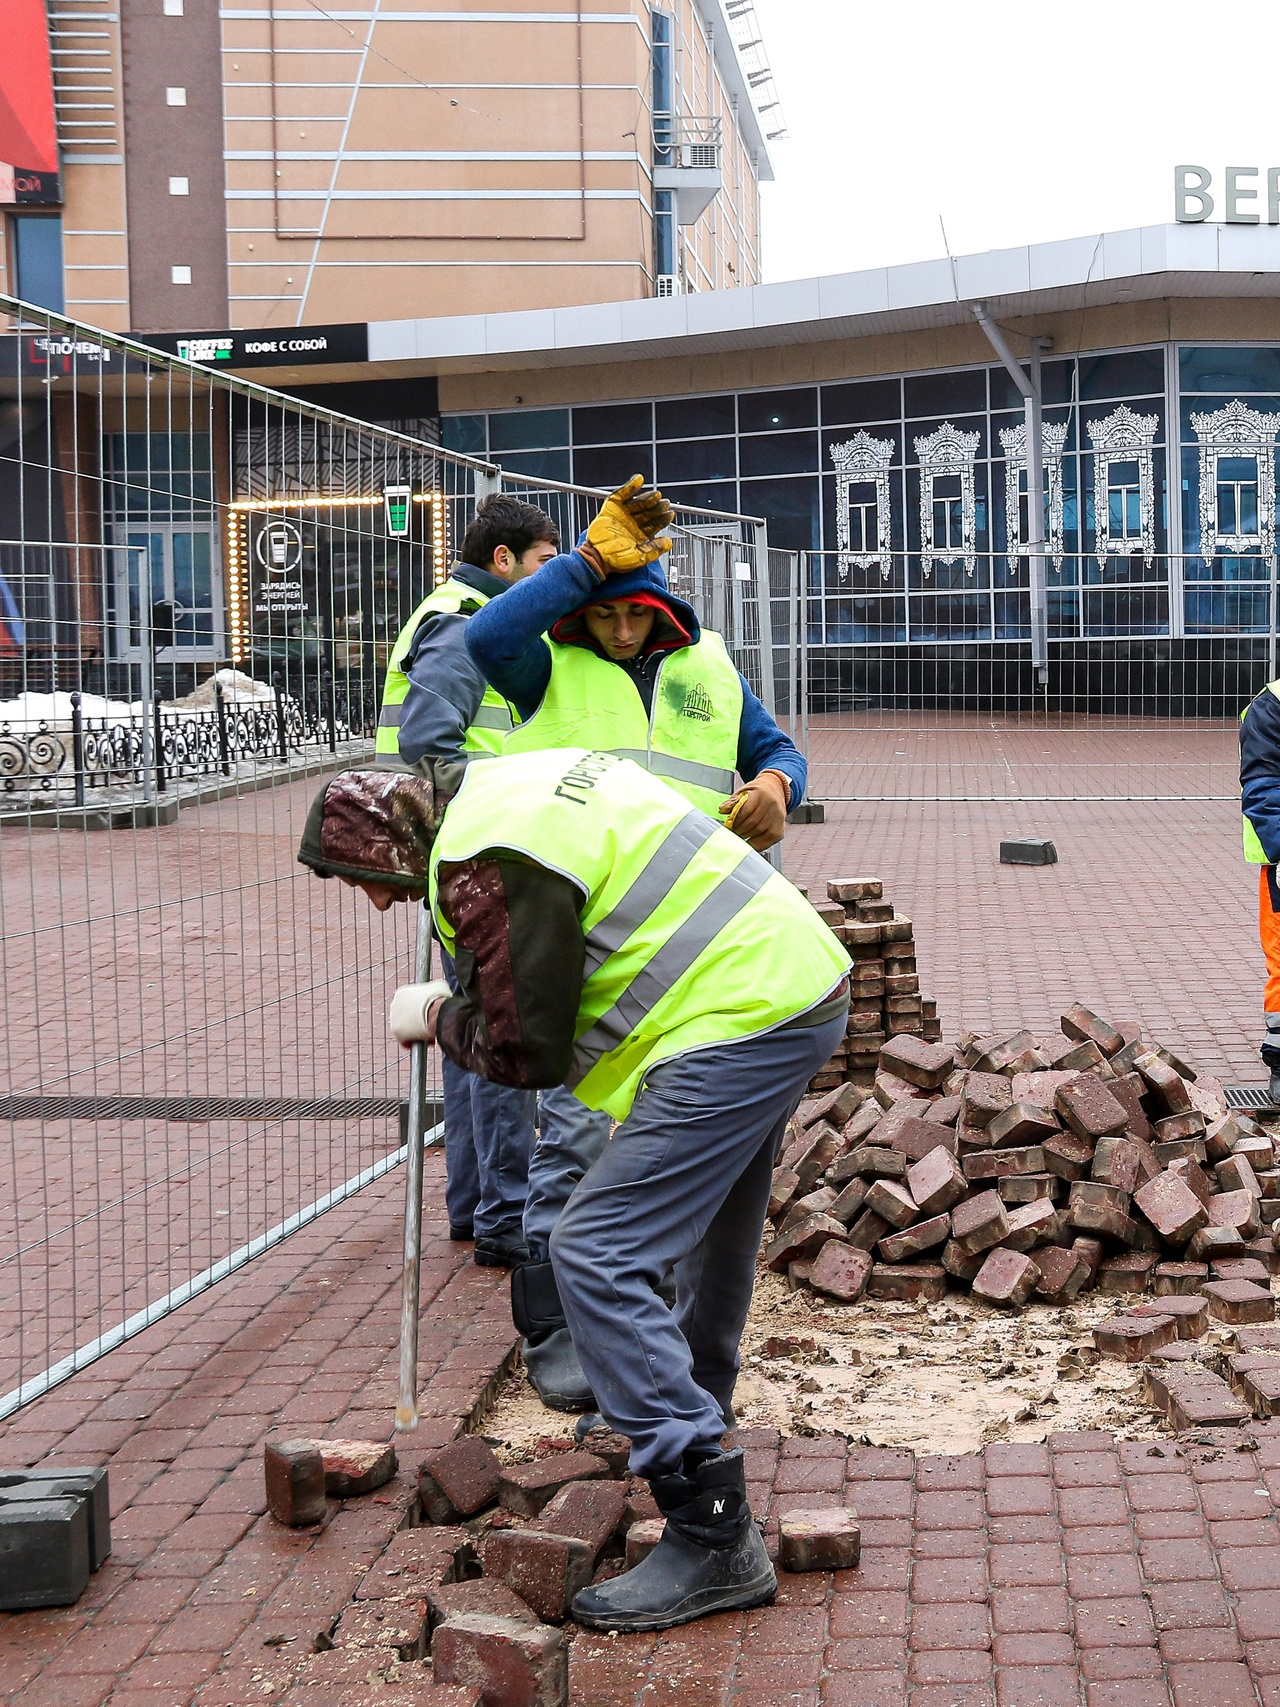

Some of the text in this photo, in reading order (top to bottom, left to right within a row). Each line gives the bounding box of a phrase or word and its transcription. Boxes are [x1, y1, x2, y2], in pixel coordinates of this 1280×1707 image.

[189, 338, 234, 351] COFFEE
[245, 336, 328, 354] КОФЕ С СОБОЙ
[189, 349, 216, 361] LIKE
